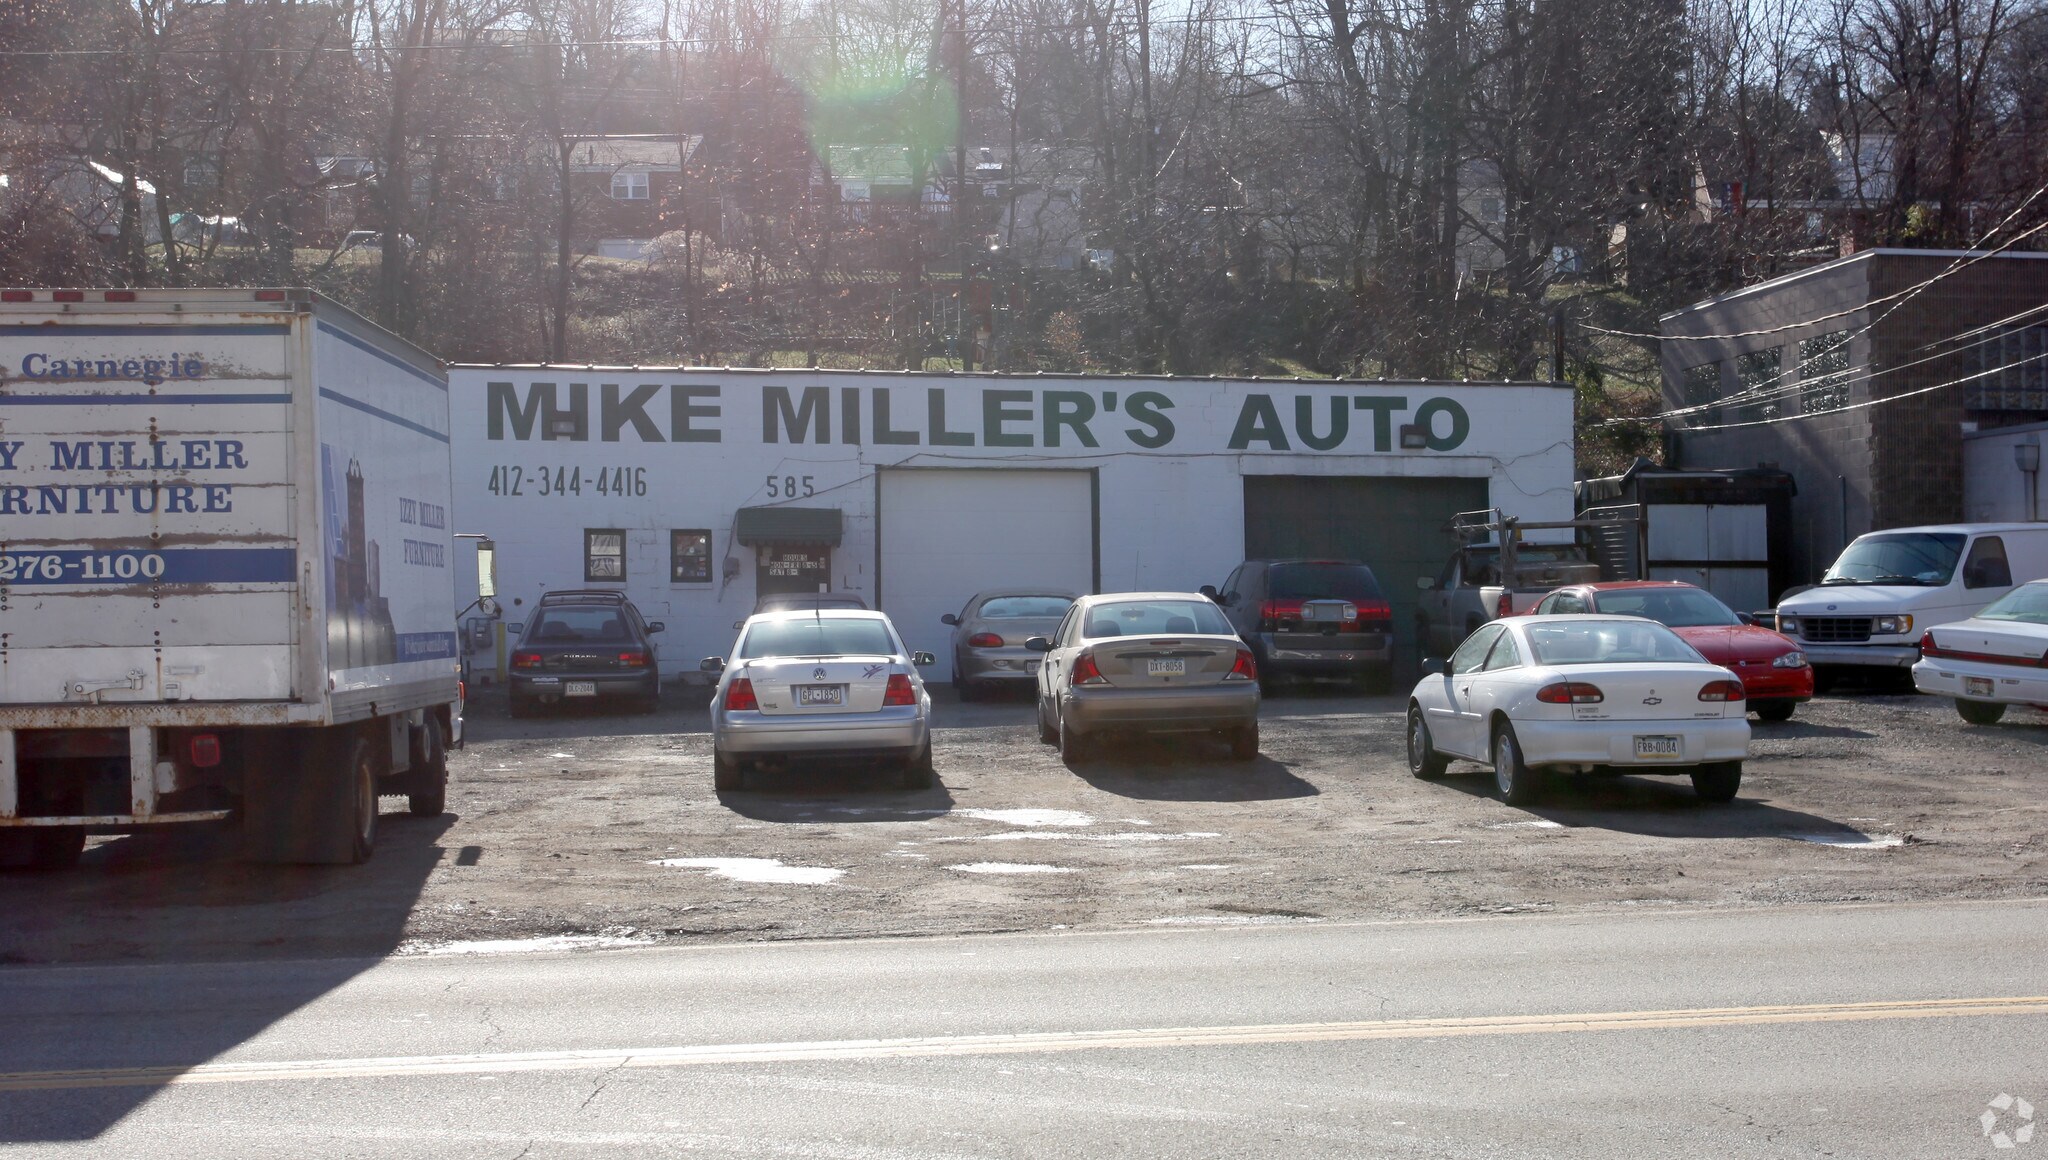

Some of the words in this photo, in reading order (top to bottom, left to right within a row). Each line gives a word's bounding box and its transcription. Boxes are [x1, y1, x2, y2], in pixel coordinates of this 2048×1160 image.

[22, 353, 201, 385] Carnegie
[487, 382, 722, 443] MIKE
[762, 386, 1176, 448] MILLER'S
[1227, 394, 1470, 452] AUTO
[50, 440, 248, 471] MILLER
[488, 465, 647, 496] 412-344-4416
[766, 476, 815, 497] 585
[399, 497, 417, 525] IZZY
[419, 501, 446, 530] MILLER
[404, 538, 445, 568] FURNITURE
[783, 554, 807, 562] HOURS
